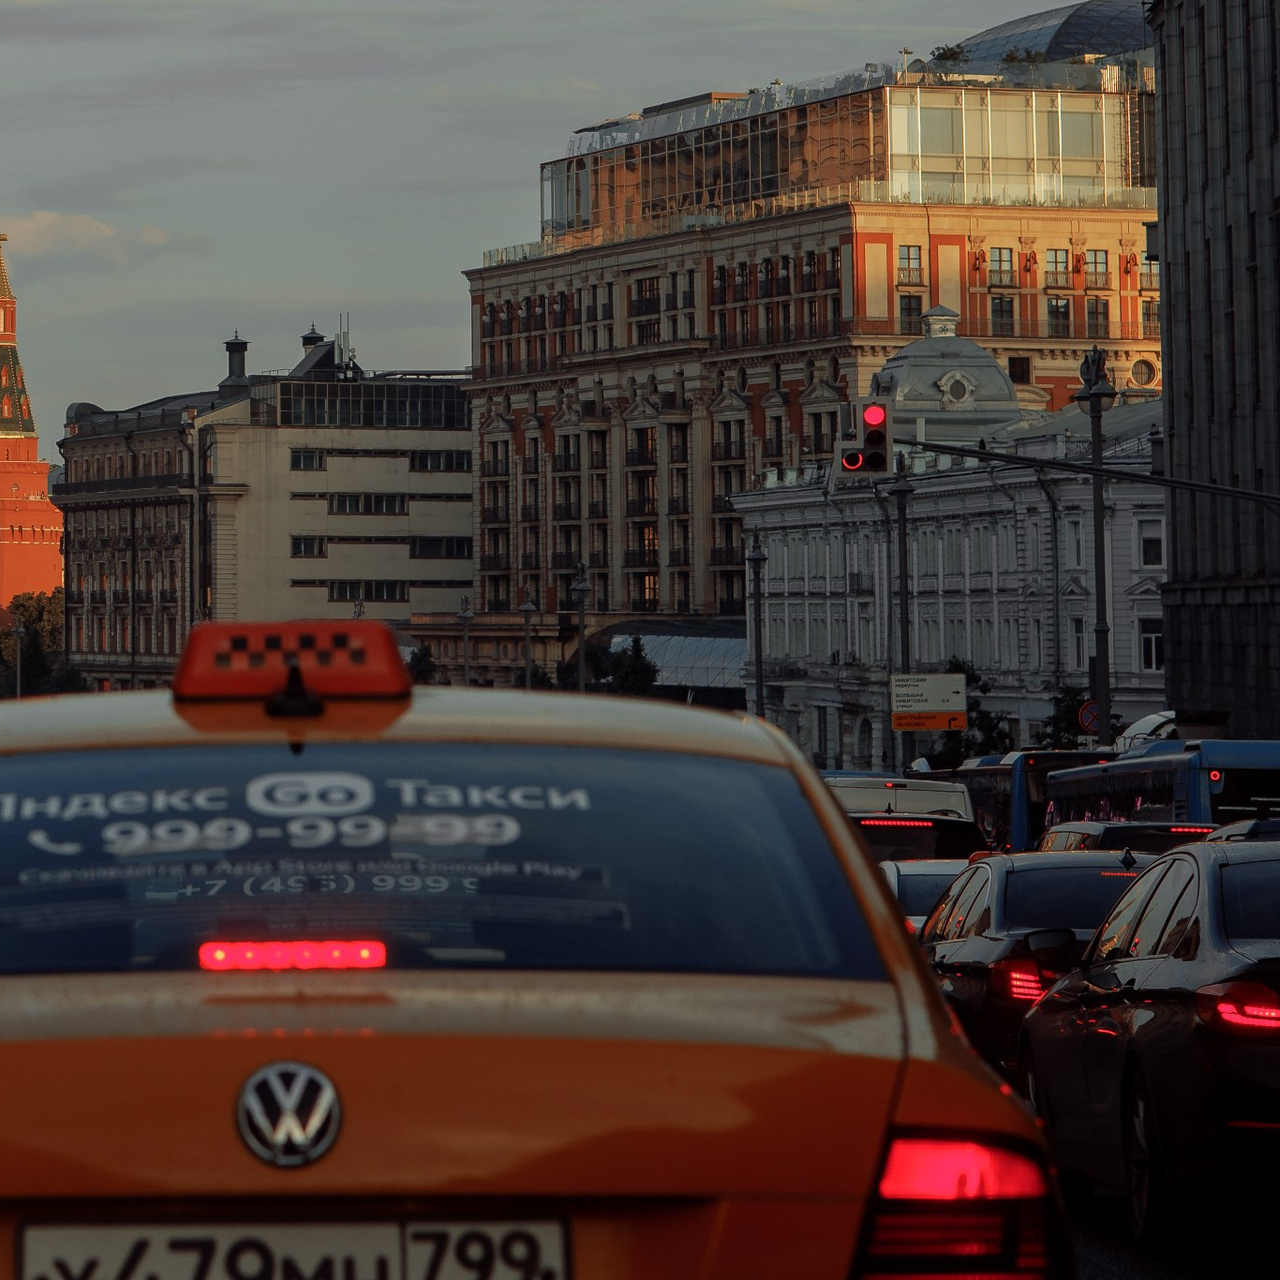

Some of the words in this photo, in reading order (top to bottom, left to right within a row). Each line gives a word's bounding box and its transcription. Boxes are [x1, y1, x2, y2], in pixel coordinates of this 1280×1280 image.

[386, 777, 591, 811] Такси
[101, 813, 521, 855] 999-99-99
[523, 860, 583, 881] Play
[179, 879, 227, 897] +7
[411, 1232, 542, 1280] 799
